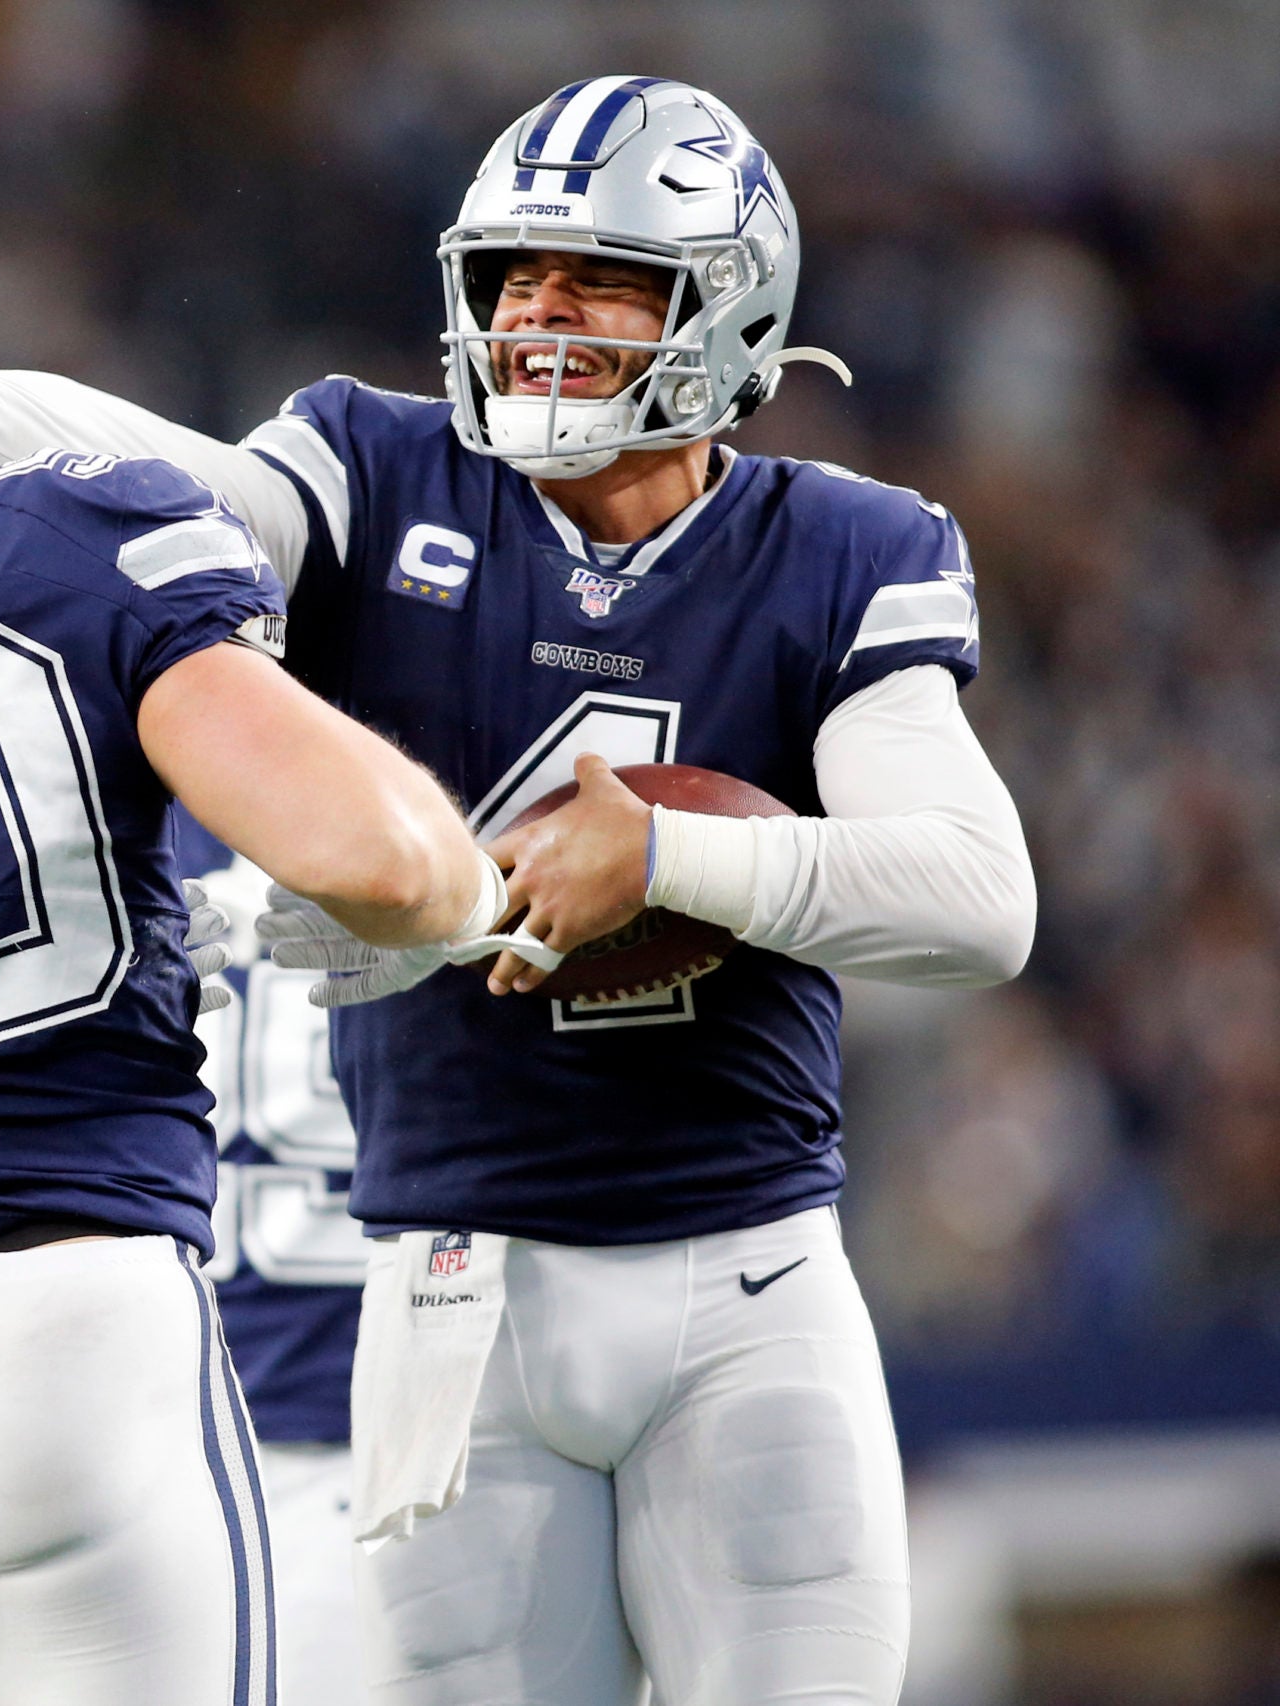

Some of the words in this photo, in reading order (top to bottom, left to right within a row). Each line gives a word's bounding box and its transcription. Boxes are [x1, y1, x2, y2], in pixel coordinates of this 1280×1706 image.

[398, 523, 476, 588] C
[531, 641, 644, 680] COWBOYS
[431, 1249, 467, 1275] NFL
[411, 1291, 475, 1308] Wilson
